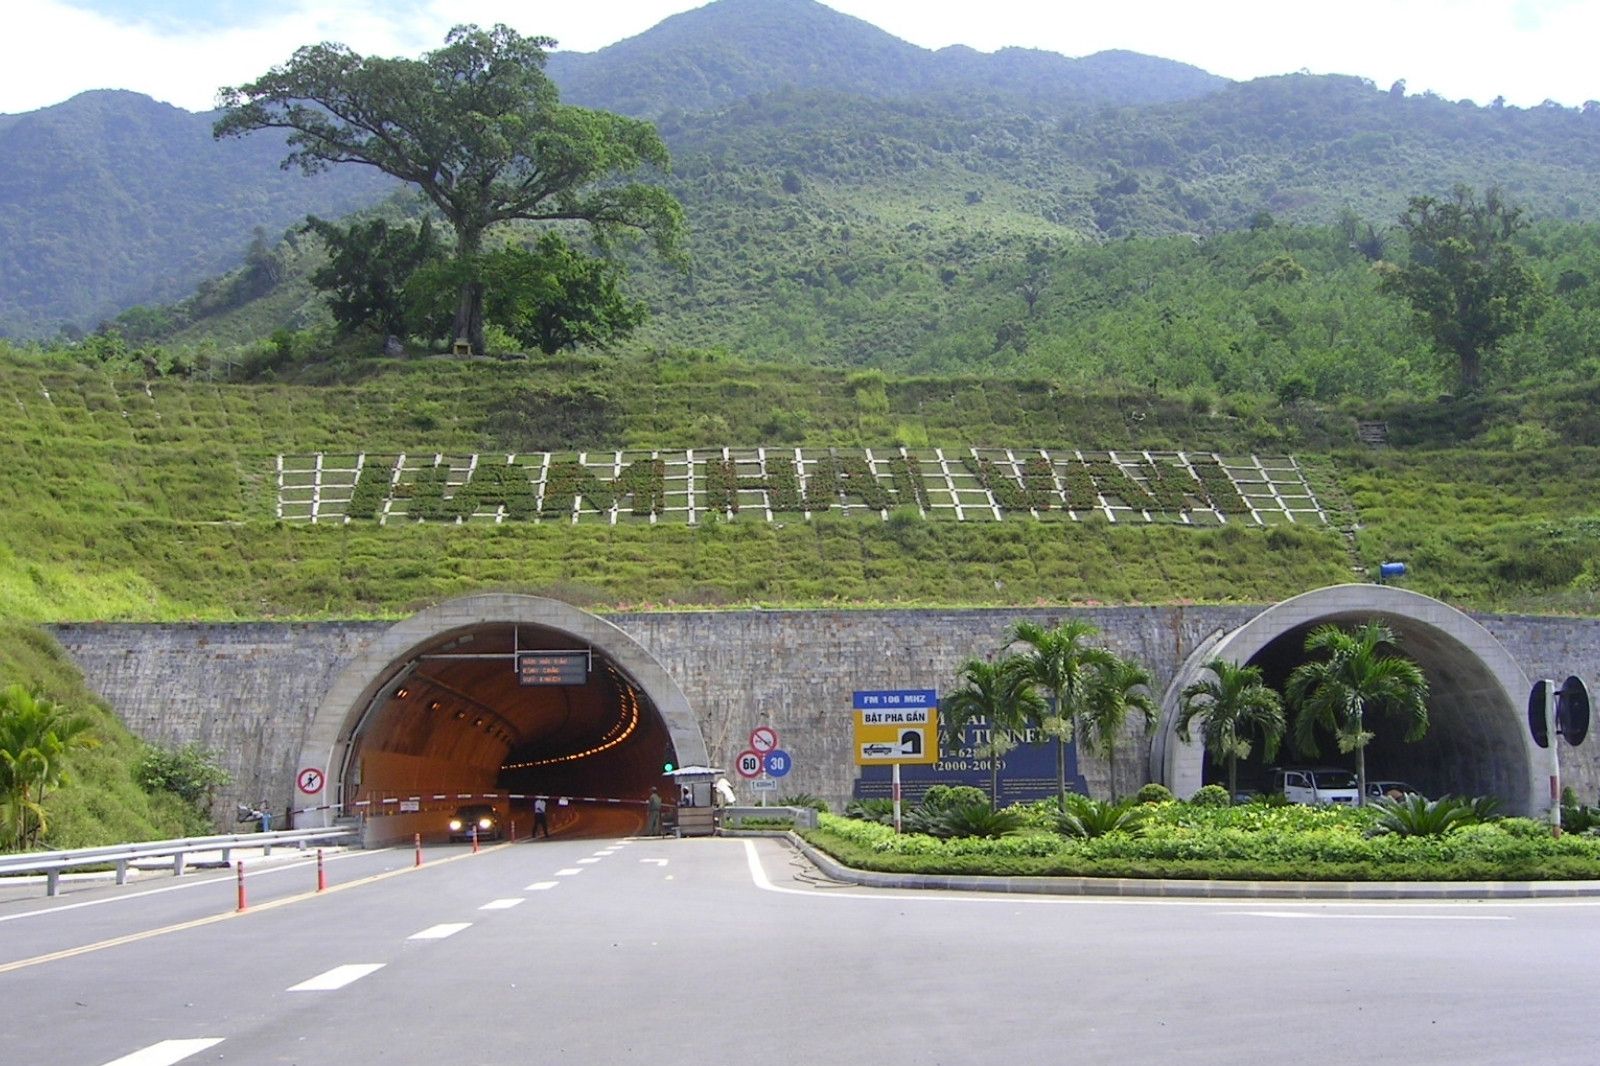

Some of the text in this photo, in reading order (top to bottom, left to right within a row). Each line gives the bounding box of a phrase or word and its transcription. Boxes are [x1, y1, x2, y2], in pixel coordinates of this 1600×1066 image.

[864, 695, 926, 704] FM 106 MHZ
[885, 713, 904, 722] PHA
[743, 758, 756, 770] 60
[770, 757, 784, 770] 30
